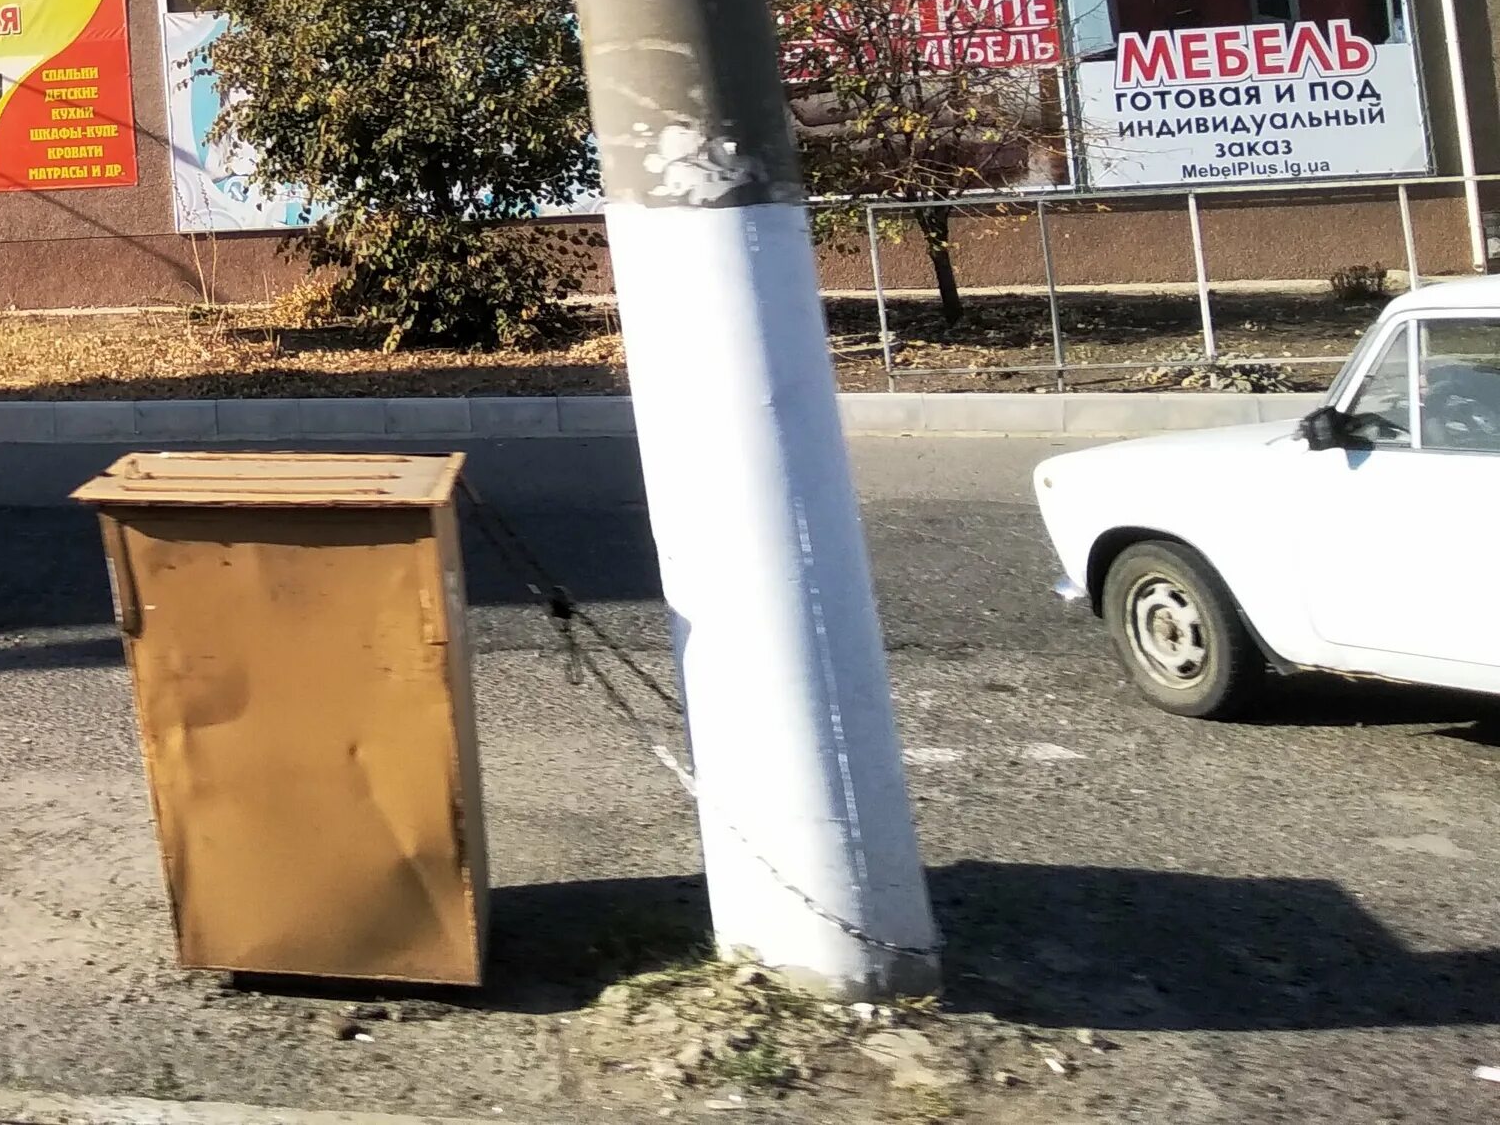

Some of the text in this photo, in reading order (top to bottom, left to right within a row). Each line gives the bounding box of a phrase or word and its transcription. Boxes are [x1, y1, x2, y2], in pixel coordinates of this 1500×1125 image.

[1114, 18, 1377, 89] МЕБЕЛЬ
[41, 66, 99, 82] СПАЛЬНИ
[45, 86, 99, 102] ДЕТСКИЕ
[51, 107, 94, 120] КУХНИ
[29, 125, 119, 141] ШКАФЫ-КУПЕ
[47, 145, 103, 160] КРОВАТИ
[1215, 139, 1293, 159] заказ
[28, 164, 126, 180] МАТРАСЫ И ДР.
[1182, 159, 1330, 179] MebelPlus.lg.ua
